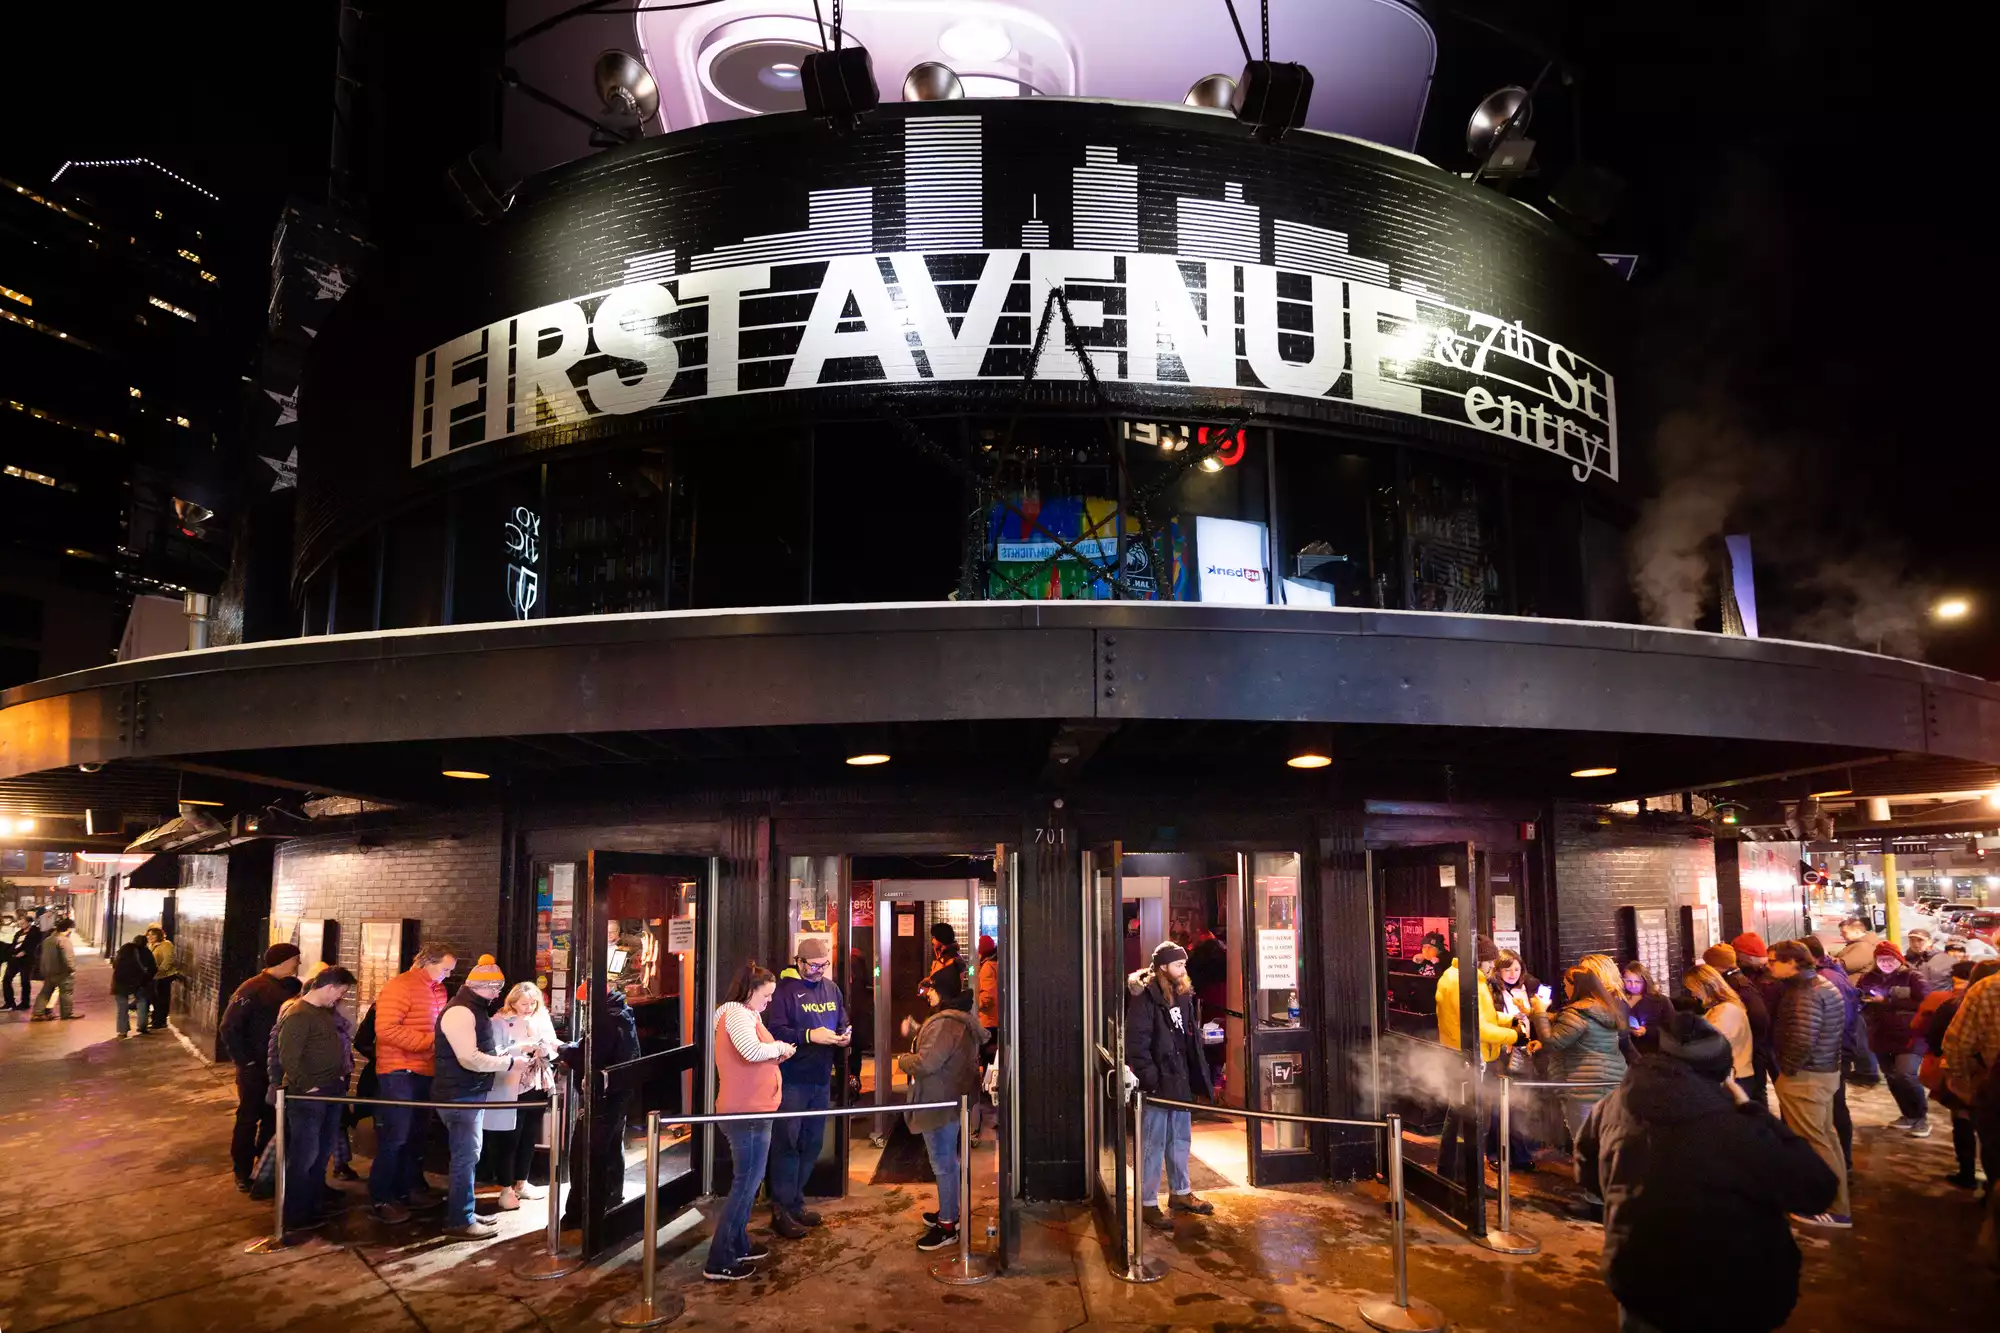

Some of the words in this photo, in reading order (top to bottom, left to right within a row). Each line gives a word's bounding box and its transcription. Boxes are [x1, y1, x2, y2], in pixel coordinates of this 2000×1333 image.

[434, 264, 771, 462] FIRST
[782, 249, 1422, 417] AVENUE
[1434, 327, 1468, 368] &
[1468, 312, 1535, 376] 7th
[1548, 343, 1600, 420] St
[1464, 385, 1604, 482] entry
[1034, 828, 1064, 844] 701
[1403, 925, 1423, 934] TAYLOR
[801, 1001, 837, 1013] WOLVES
